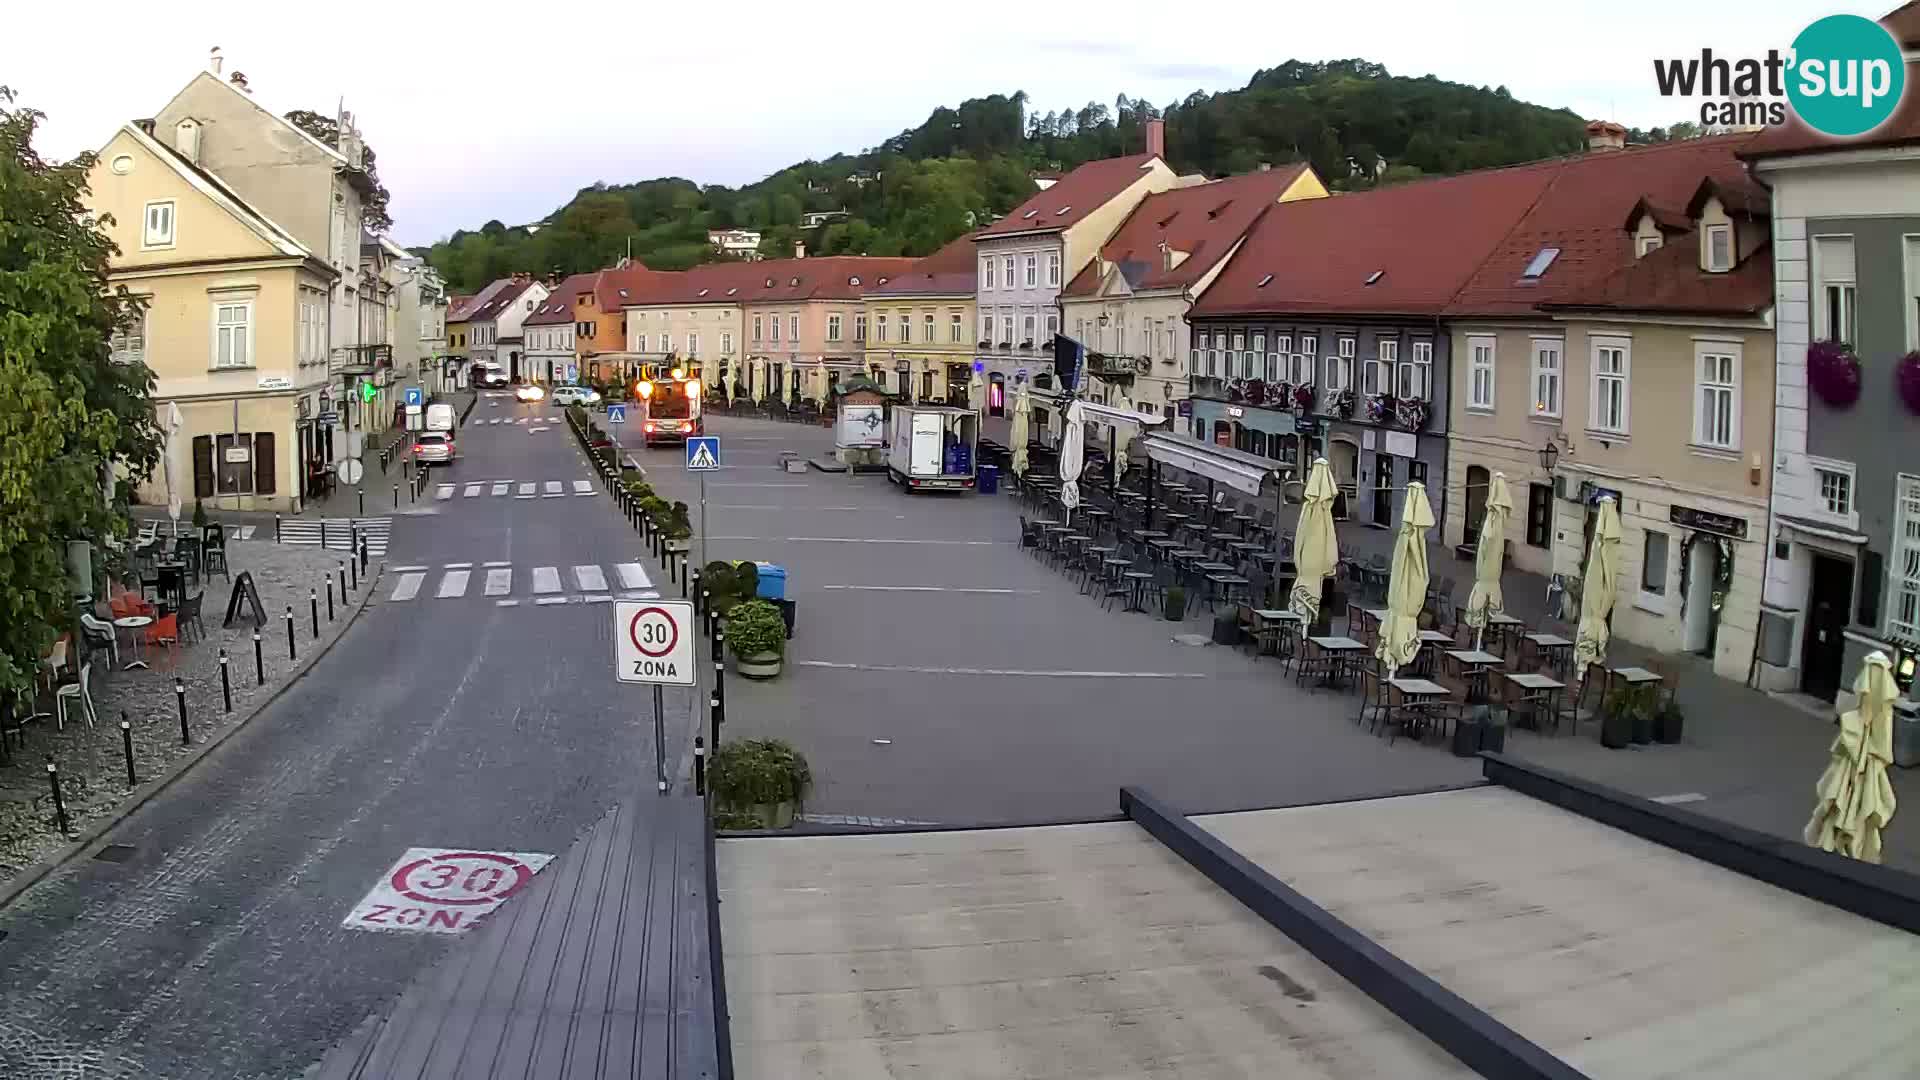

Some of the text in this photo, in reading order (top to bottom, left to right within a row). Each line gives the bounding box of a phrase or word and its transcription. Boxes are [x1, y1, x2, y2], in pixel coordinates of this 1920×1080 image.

[409, 392, 417, 403] P
[643, 623, 667, 643] 30
[633, 660, 677, 677] ZONA
[420, 864, 503, 892] 30
